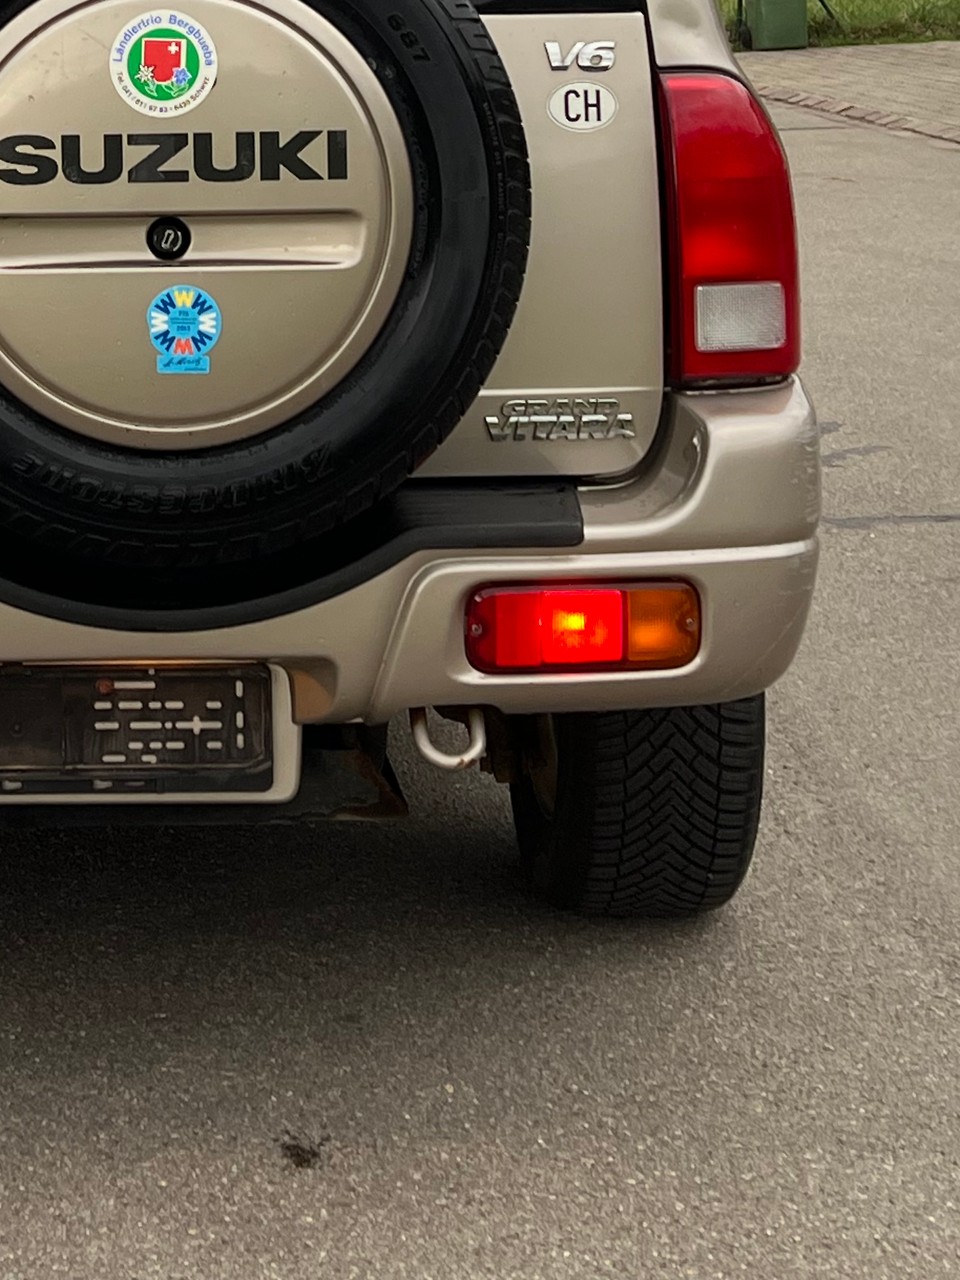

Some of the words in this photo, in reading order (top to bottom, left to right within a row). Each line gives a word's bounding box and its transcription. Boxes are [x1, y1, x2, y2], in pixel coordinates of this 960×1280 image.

[544, 40, 616, 72] V6
[564, 89, 602, 122] CH
[501, 398, 620, 417] GRAND
[484, 413, 636, 442] VITARA
